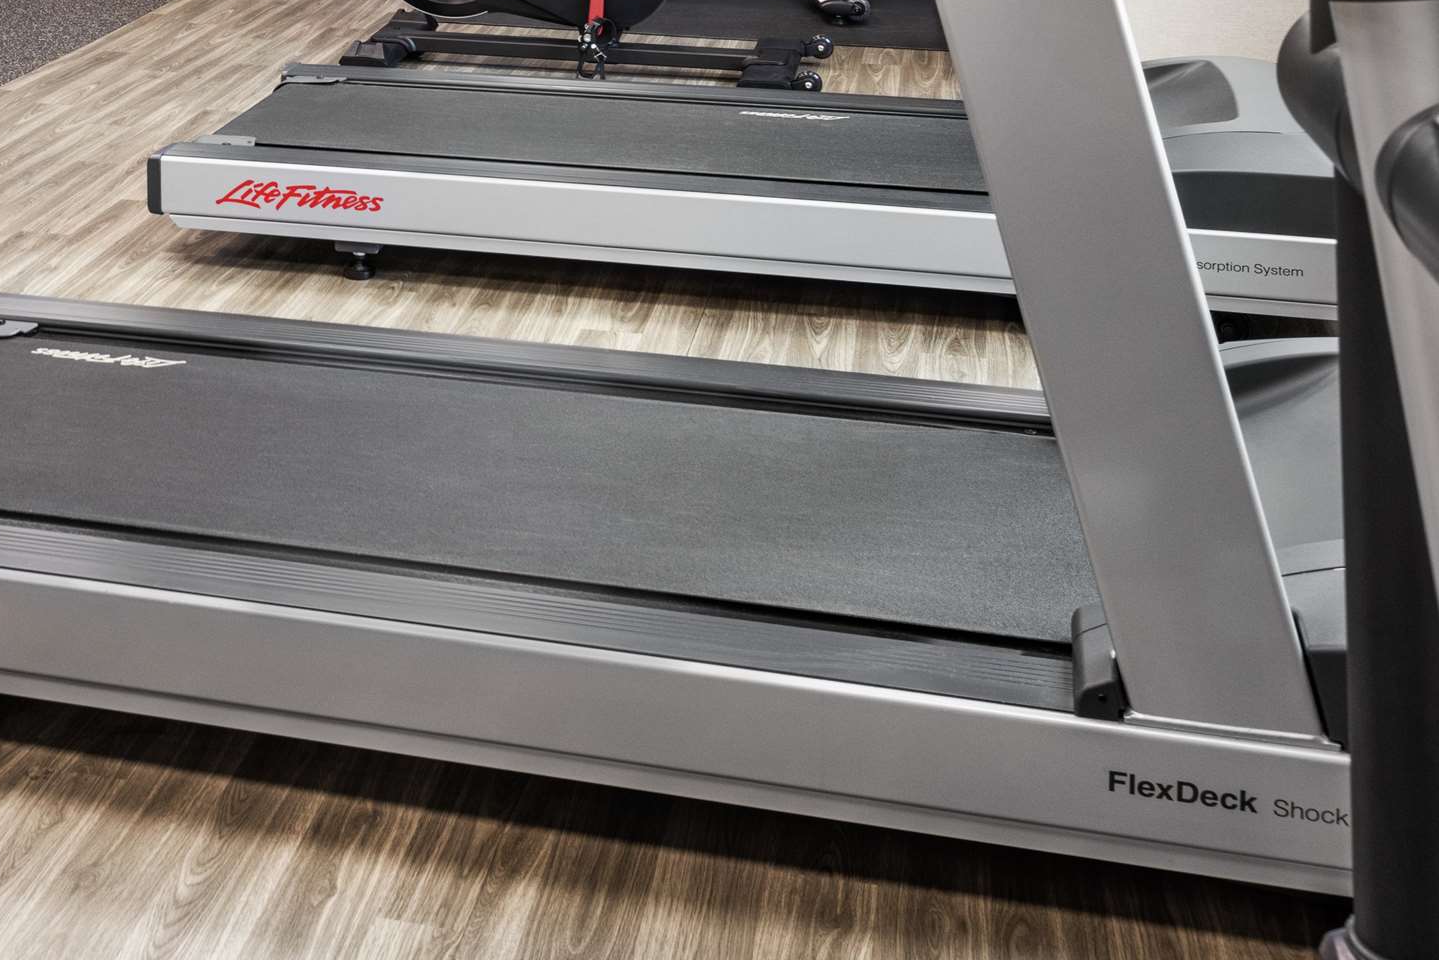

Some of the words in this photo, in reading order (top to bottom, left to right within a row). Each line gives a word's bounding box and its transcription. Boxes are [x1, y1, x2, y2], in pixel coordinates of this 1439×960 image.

[1196, 261, 1250, 274] sorption
[1254, 263, 1304, 278] System
[1108, 770, 1258, 814] FlexDeck
[1273, 799, 1350, 826] Shock
